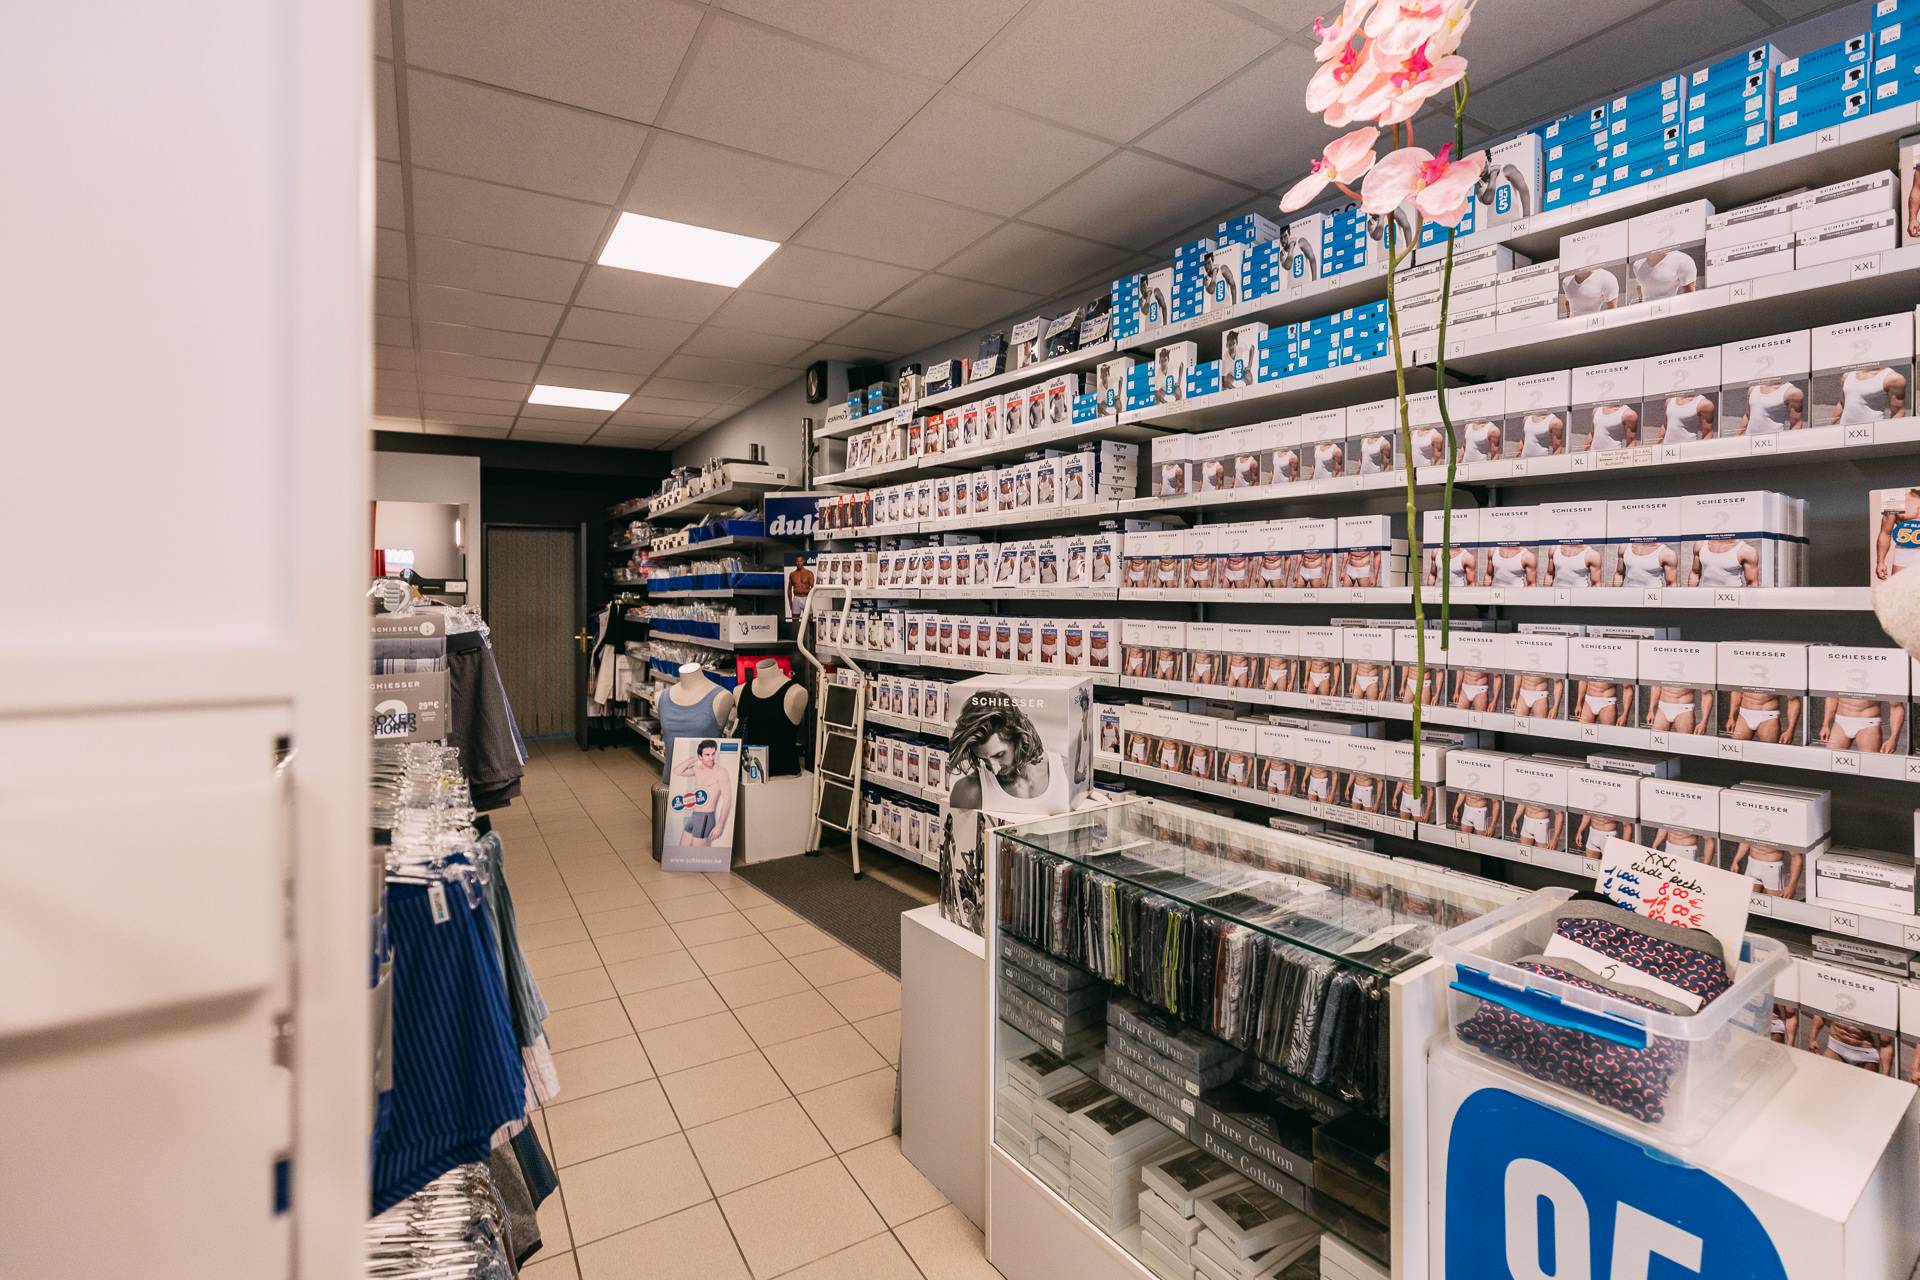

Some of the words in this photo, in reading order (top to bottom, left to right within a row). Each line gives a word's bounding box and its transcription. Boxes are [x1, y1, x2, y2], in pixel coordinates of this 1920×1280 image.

[1821, 134, 1835, 143] XL
[1819, 180, 1861, 194] SCHIESSER
[1731, 205, 1768, 216] SCHIESSER
[1513, 224, 1527, 232] XXL
[1823, 219, 1865, 231] SCHIESSER
[1454, 242, 1464, 250] XL
[1731, 241, 1769, 252] SCHIESSER
[1854, 261, 1876, 271] XXL
[1734, 289, 1746, 297] XL
[1831, 321, 1892, 336] SCHIESSER
[1738, 338, 1792, 351] SCHIESSER
[1657, 353, 1705, 366] SCHIESSER
[1585, 366, 1629, 376] SCHIESSER
[1517, 376, 1556, 386] SCHIESSER
[1459, 386, 1494, 396] SCHIESSER
[1355, 404, 1385, 413] SCHIESSER
[1848, 429, 1870, 438] XXL
[1754, 440, 1774, 448] XXL
[1665, 449, 1676, 457] XL
[1515, 463, 1524, 471] XL
[1574, 458, 1584, 466] XL
[1696, 497, 1746, 506] SCHIESSER
[1647, 593, 1658, 601] XL
[1717, 593, 1736, 601] XXL
[1580, 643, 1622, 651] SCHIESSER
[1733, 649, 1786, 658] SCHIESSER
[1828, 653, 1887, 662] SCHIESSER
[971, 697, 1044, 708] SCHIESSER
[1584, 728, 1595, 736] XL
[1654, 736, 1664, 745] XL
[1348, 743, 1376, 751] SCHIESSER
[1721, 744, 1739, 753] XXL
[1456, 759, 1491, 768] SCHIESSER
[1835, 756, 1856, 767] XXL
[1515, 768, 1554, 778] SCHIESSER
[1580, 777, 1622, 788] SCHIESSER
[1655, 789, 1702, 800] SCHIESSER
[1736, 800, 1788, 814] SCHIESSER
[1519, 849, 1529, 857] XL
[1586, 863, 1596, 871] XL
[1843, 867, 1884, 878] SCHIESSER
[1750, 897, 1768, 908] XXL
[1833, 915, 1855, 928] XXL
[1837, 943, 1879, 955] SCHIESSER
[1817, 972, 1876, 993] SCHIESSER
[1119, 1012, 1143, 1037] Pure
[1148, 1031, 1184, 1062] Cotton
[1119, 1036, 1143, 1060] Pure
[1148, 1056, 1184, 1088] Cotton
[1115, 1056, 1139, 1081] Pure
[1145, 1071, 1182, 1108] Cotton
[1259, 1061, 1286, 1089] Pure
[1292, 1082, 1335, 1118] Cotton
[1110, 1074, 1133, 1099] Pure
[1138, 1093, 1174, 1123] Cotton
[1212, 1113, 1241, 1143] Pure
[1249, 1135, 1293, 1173] Cotton
[1205, 1132, 1233, 1162] Pure
[1240, 1155, 1284, 1196] Cotton
